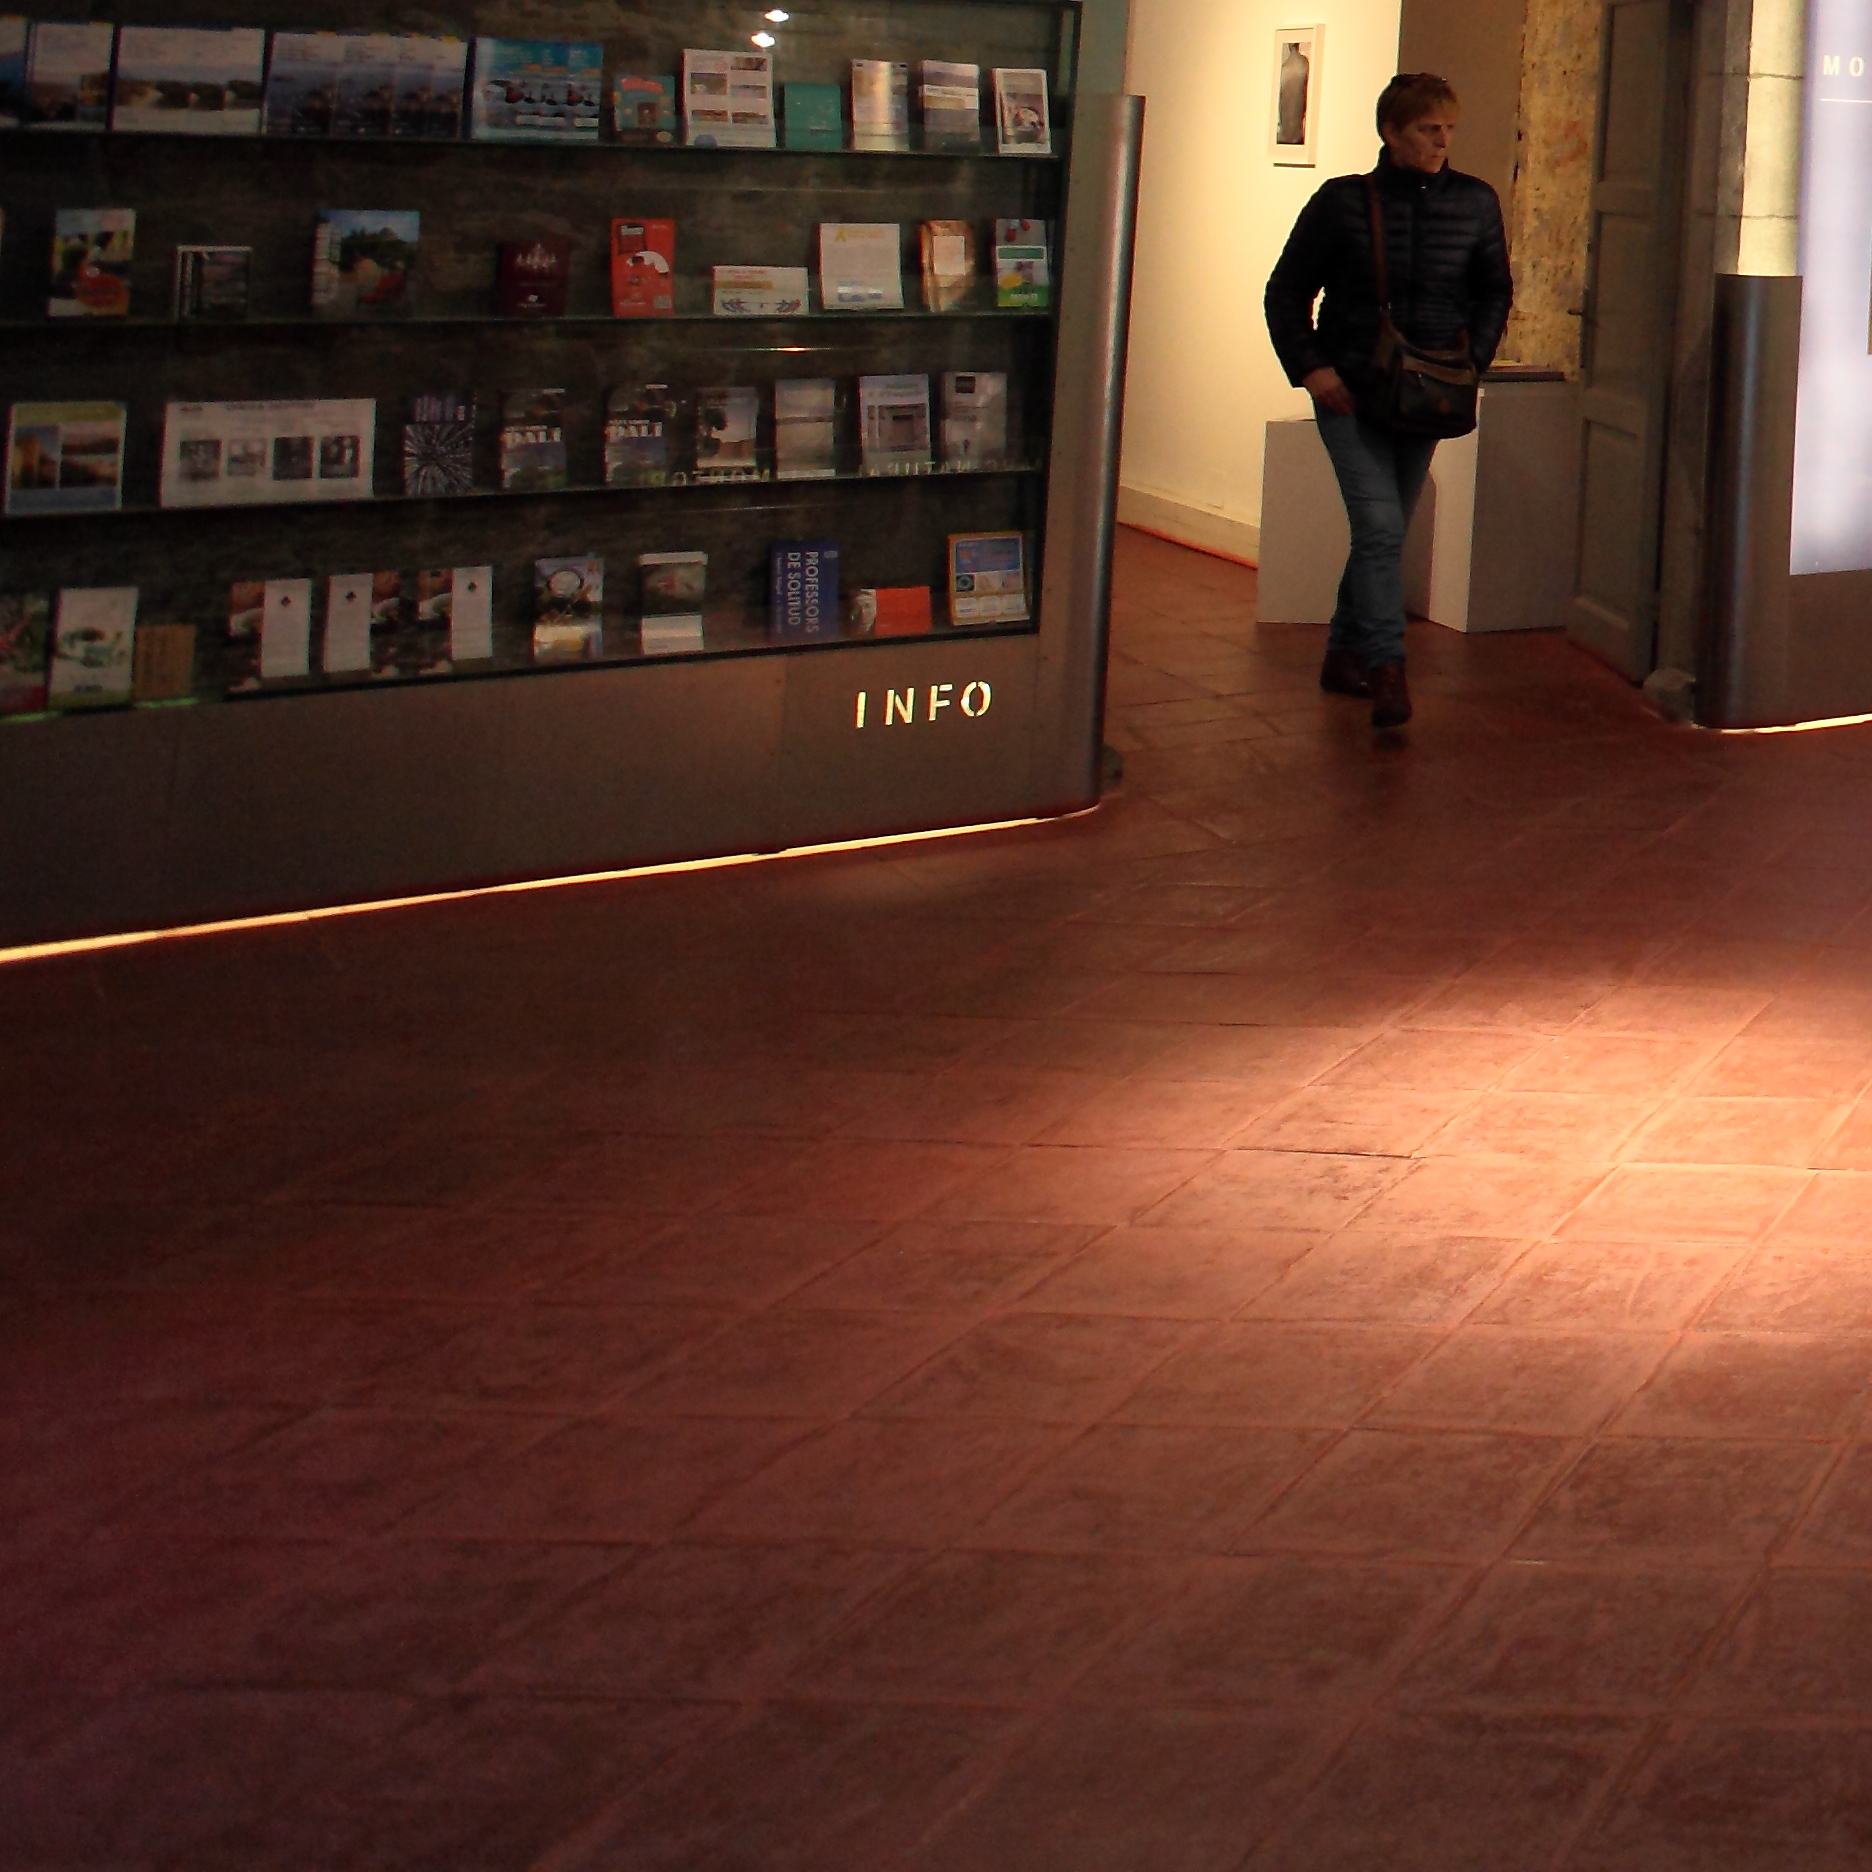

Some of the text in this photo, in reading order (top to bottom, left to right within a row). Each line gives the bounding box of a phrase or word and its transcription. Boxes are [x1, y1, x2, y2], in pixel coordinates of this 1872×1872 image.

[787, 552, 802, 569] DE
[805, 551, 820, 633] PROFESSORS
[855, 680, 993, 729] INFO
